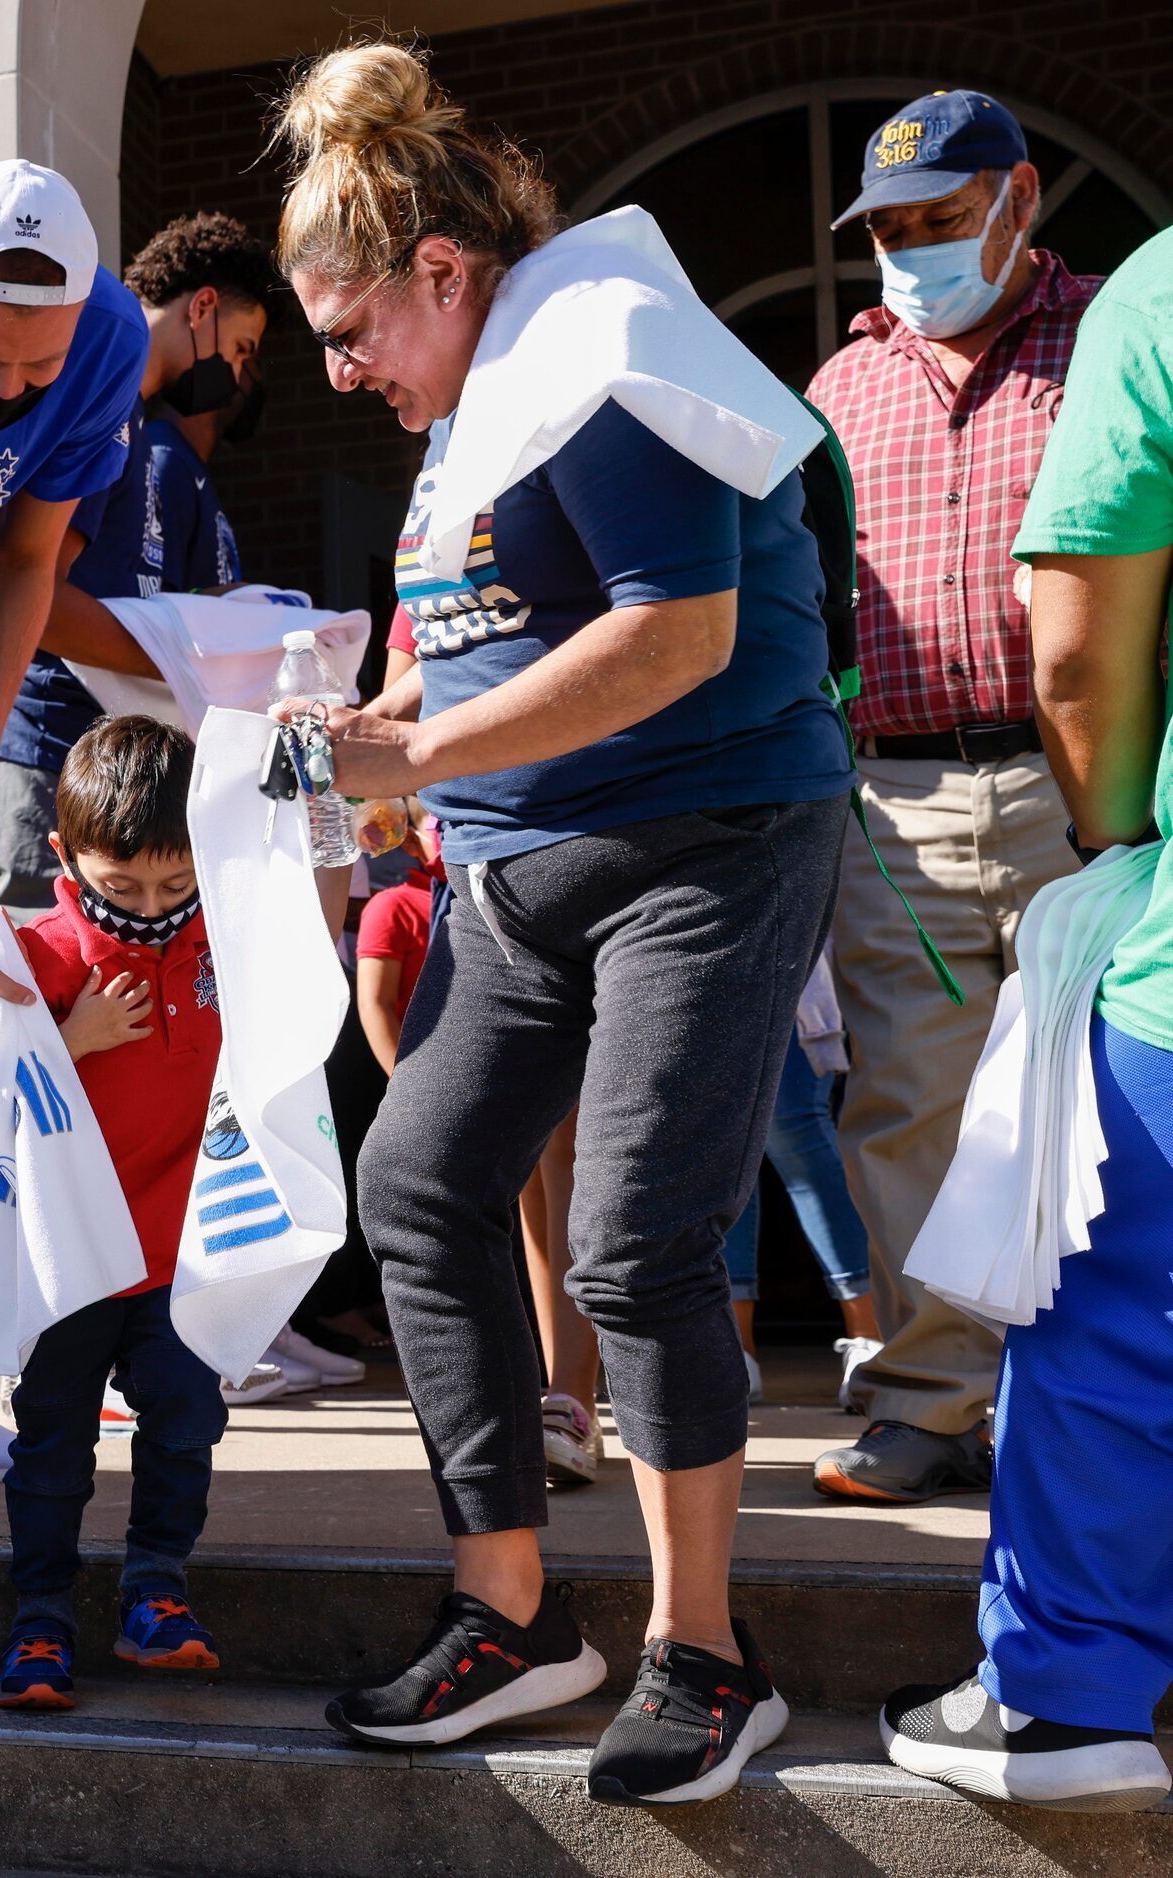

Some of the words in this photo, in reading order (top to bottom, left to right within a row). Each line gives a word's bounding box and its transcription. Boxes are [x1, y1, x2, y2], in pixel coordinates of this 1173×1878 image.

[874, 119, 924, 153] John
[875, 141, 918, 169] 3:16
[14, 230, 41, 239] adidas
